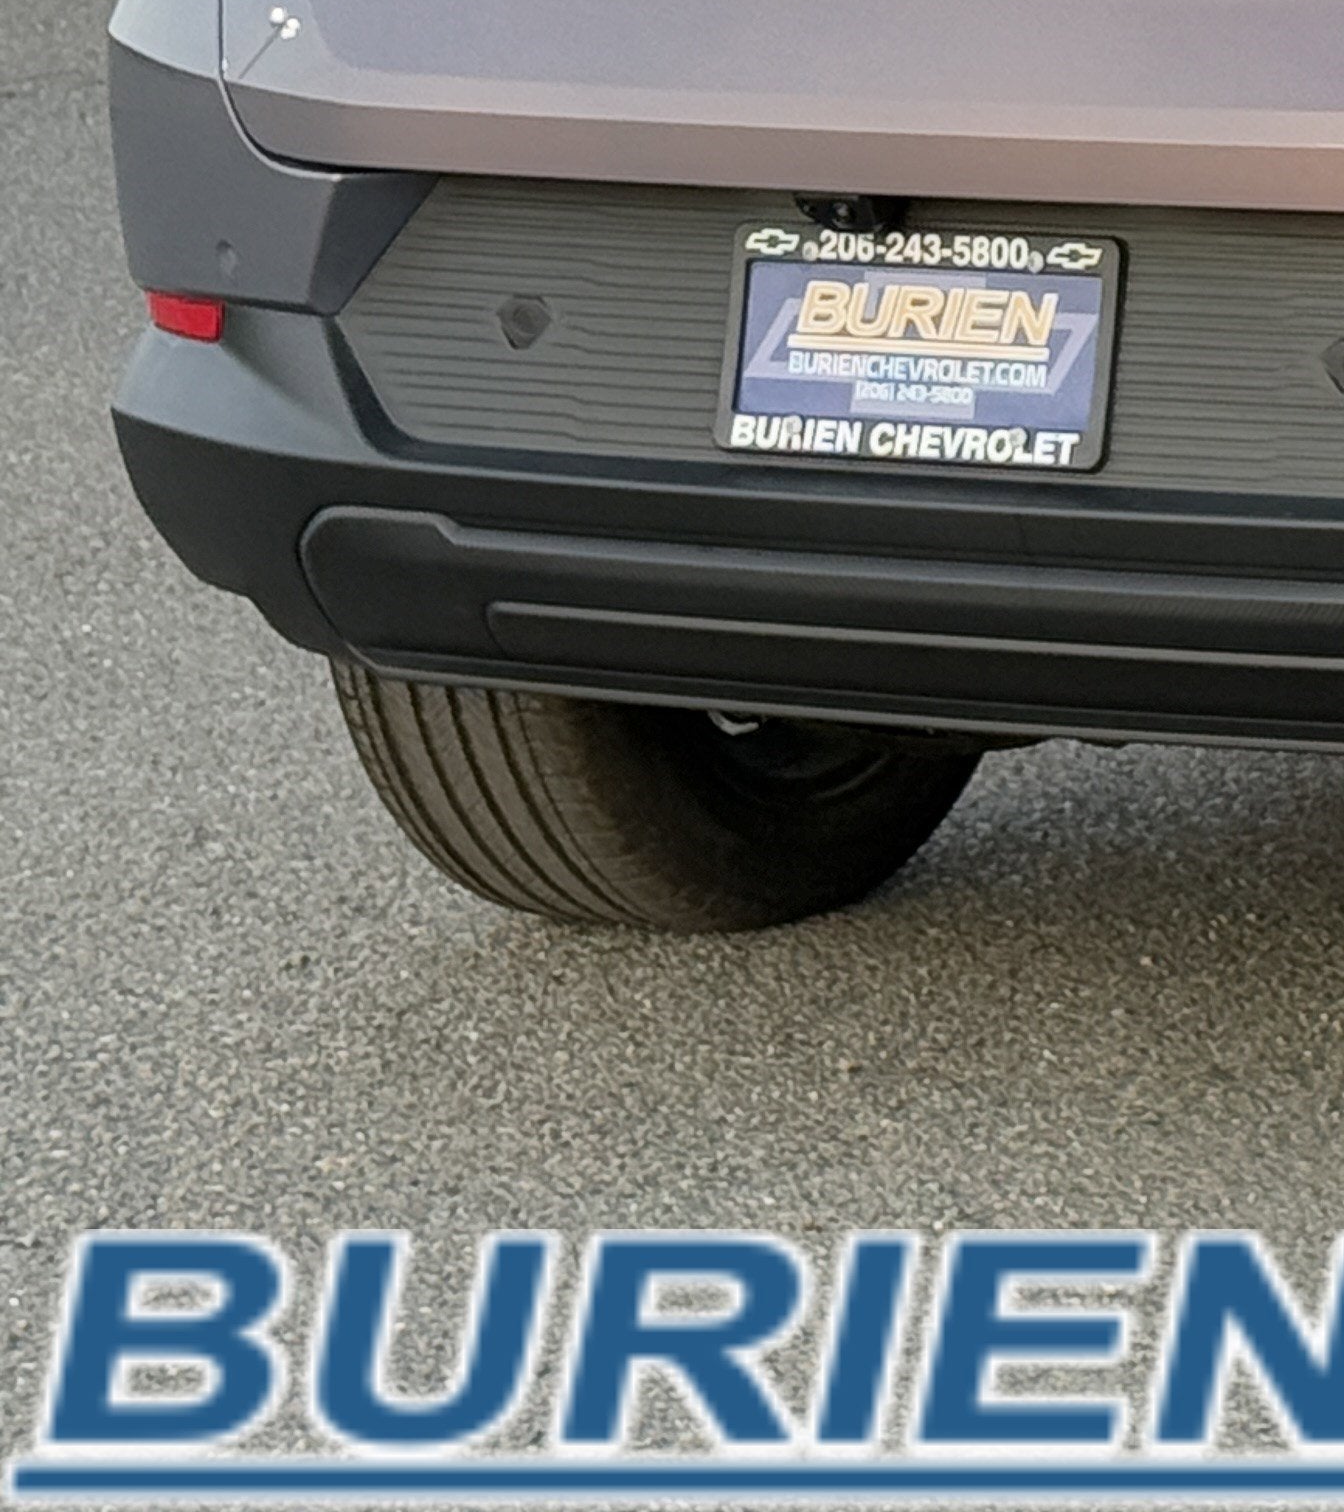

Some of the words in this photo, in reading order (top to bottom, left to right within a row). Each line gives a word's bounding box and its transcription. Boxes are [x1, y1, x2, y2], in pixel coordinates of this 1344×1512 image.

[818, 230, 1030, 271] 206-243-5800
[796, 280, 1060, 347] BURIEN
[787, 351, 1049, 389] BURIENCHEVROLET.COM
[731, 414, 862, 457] BURIEN
[869, 422, 1081, 466] CHEVROLET
